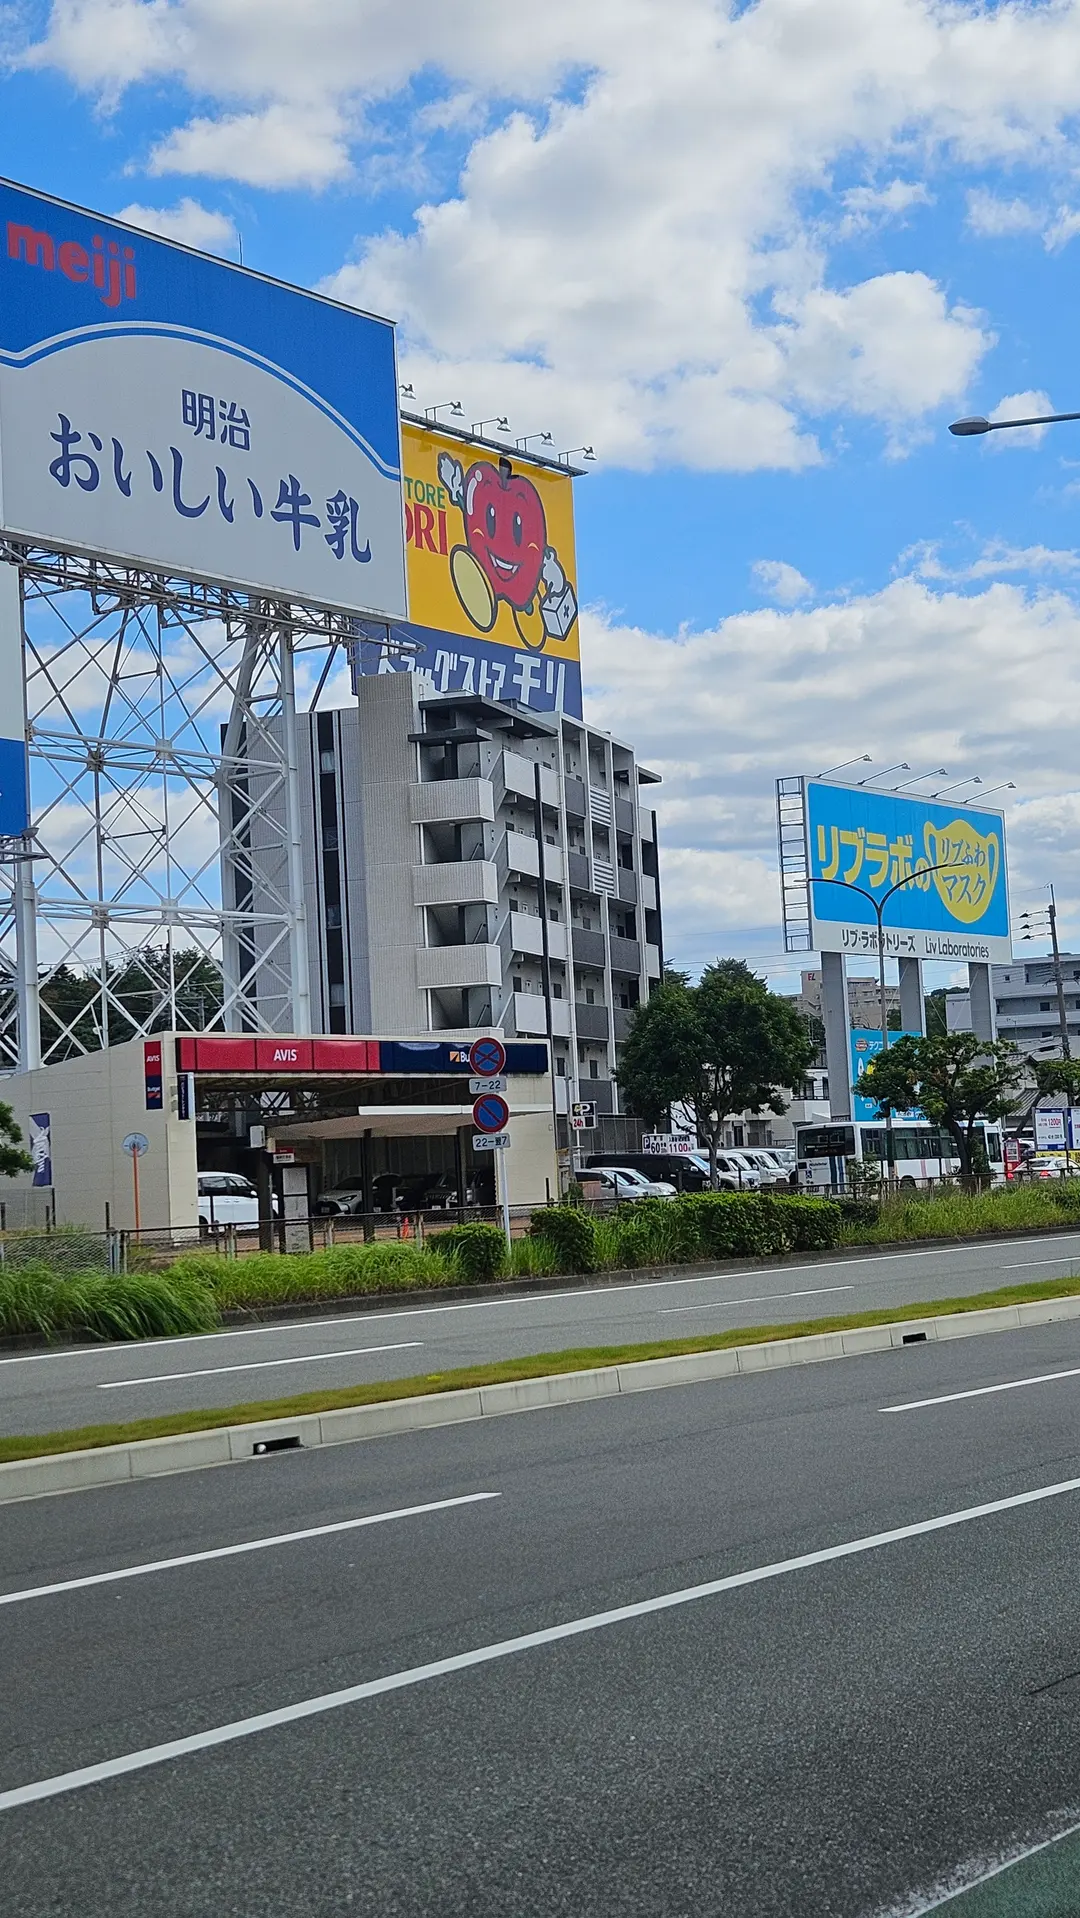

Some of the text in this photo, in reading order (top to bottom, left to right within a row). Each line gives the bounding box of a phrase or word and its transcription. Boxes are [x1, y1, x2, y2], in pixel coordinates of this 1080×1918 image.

[7, 221, 136, 308] meiji
[182, 388, 250, 452] 明治
[49, 412, 372, 563] おいしい牛乳
[817, 824, 931, 892] リブラボの
[941, 872, 987, 906] マスク
[925, 936, 990, 959] Liv Laboratories
[273, 1048, 298, 1062] AVIS
[475, 1080, 501, 1091] 7-22
